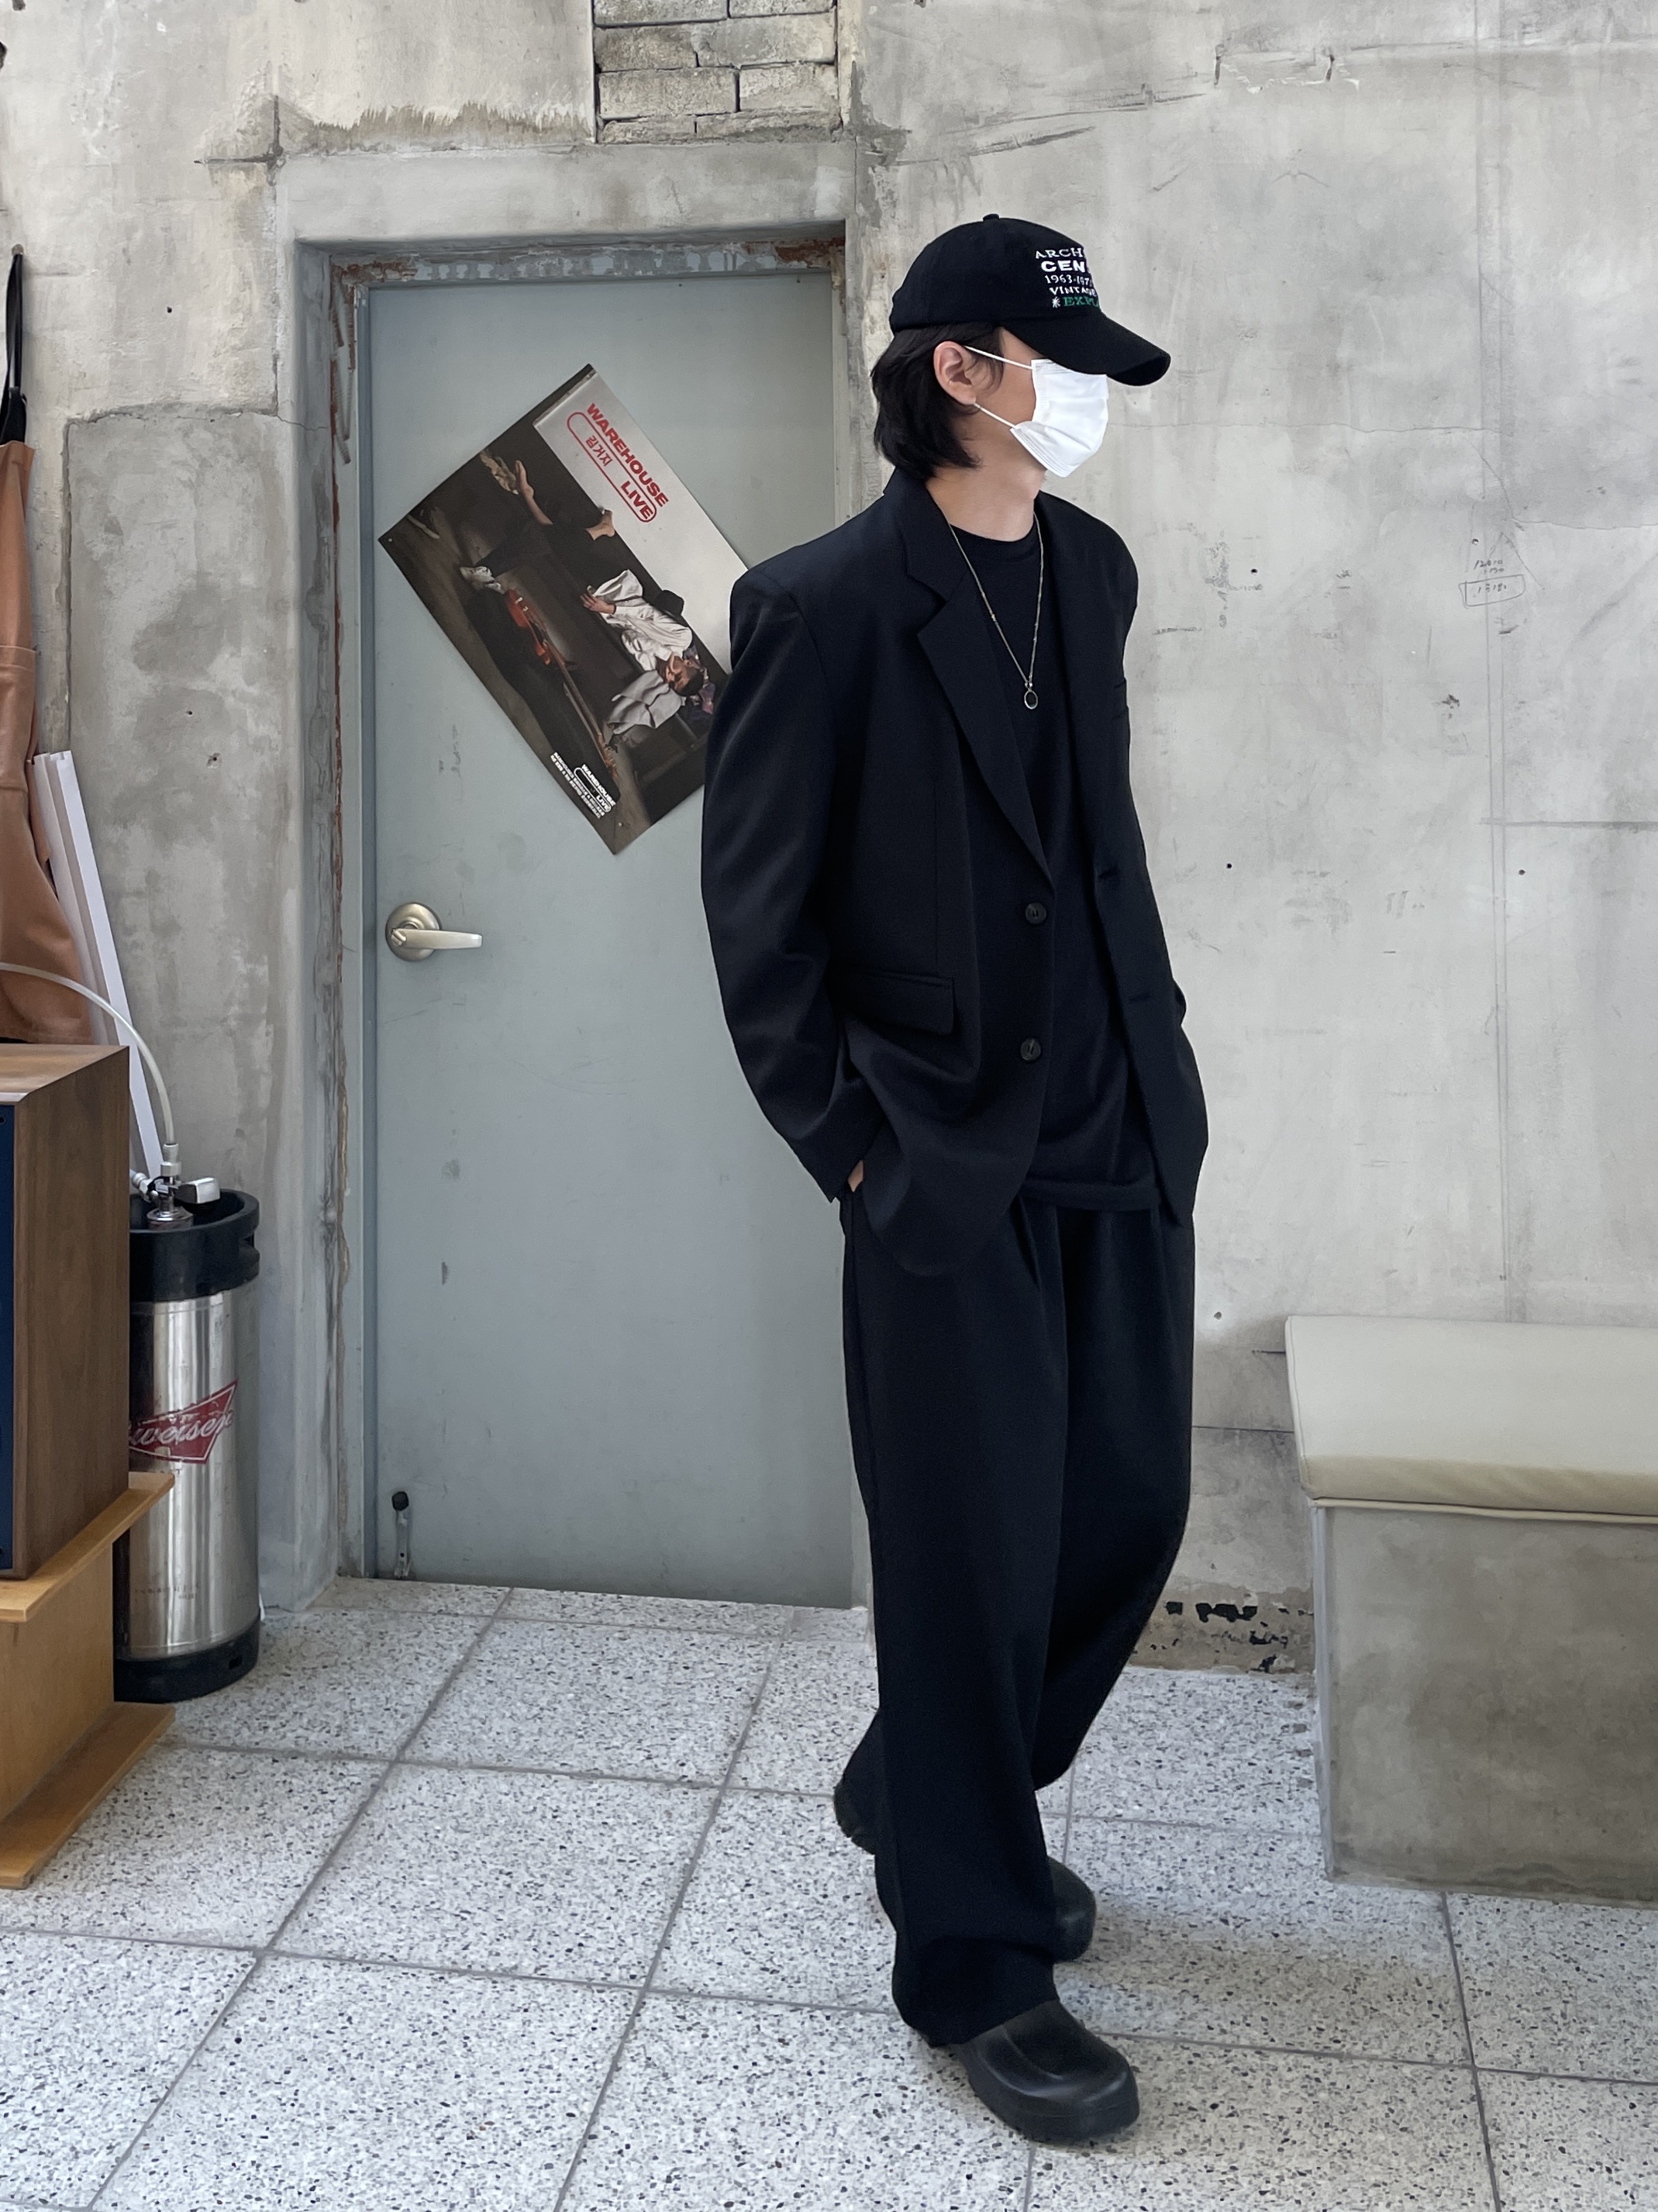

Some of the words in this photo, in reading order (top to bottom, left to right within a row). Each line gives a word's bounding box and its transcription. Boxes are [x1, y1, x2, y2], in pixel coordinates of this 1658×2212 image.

[1036, 247, 1084, 260] ARCH
[1041, 260, 1091, 273] CEN
[584, 434, 613, 467] 김거지
[587, 402, 669, 508] WAREHOUSE
[620, 480, 654, 519] LIVE
[581, 764, 616, 807] WAREHOUSE
[596, 795, 610, 811] LIVE
[129, 1410, 233, 1445] weiser
